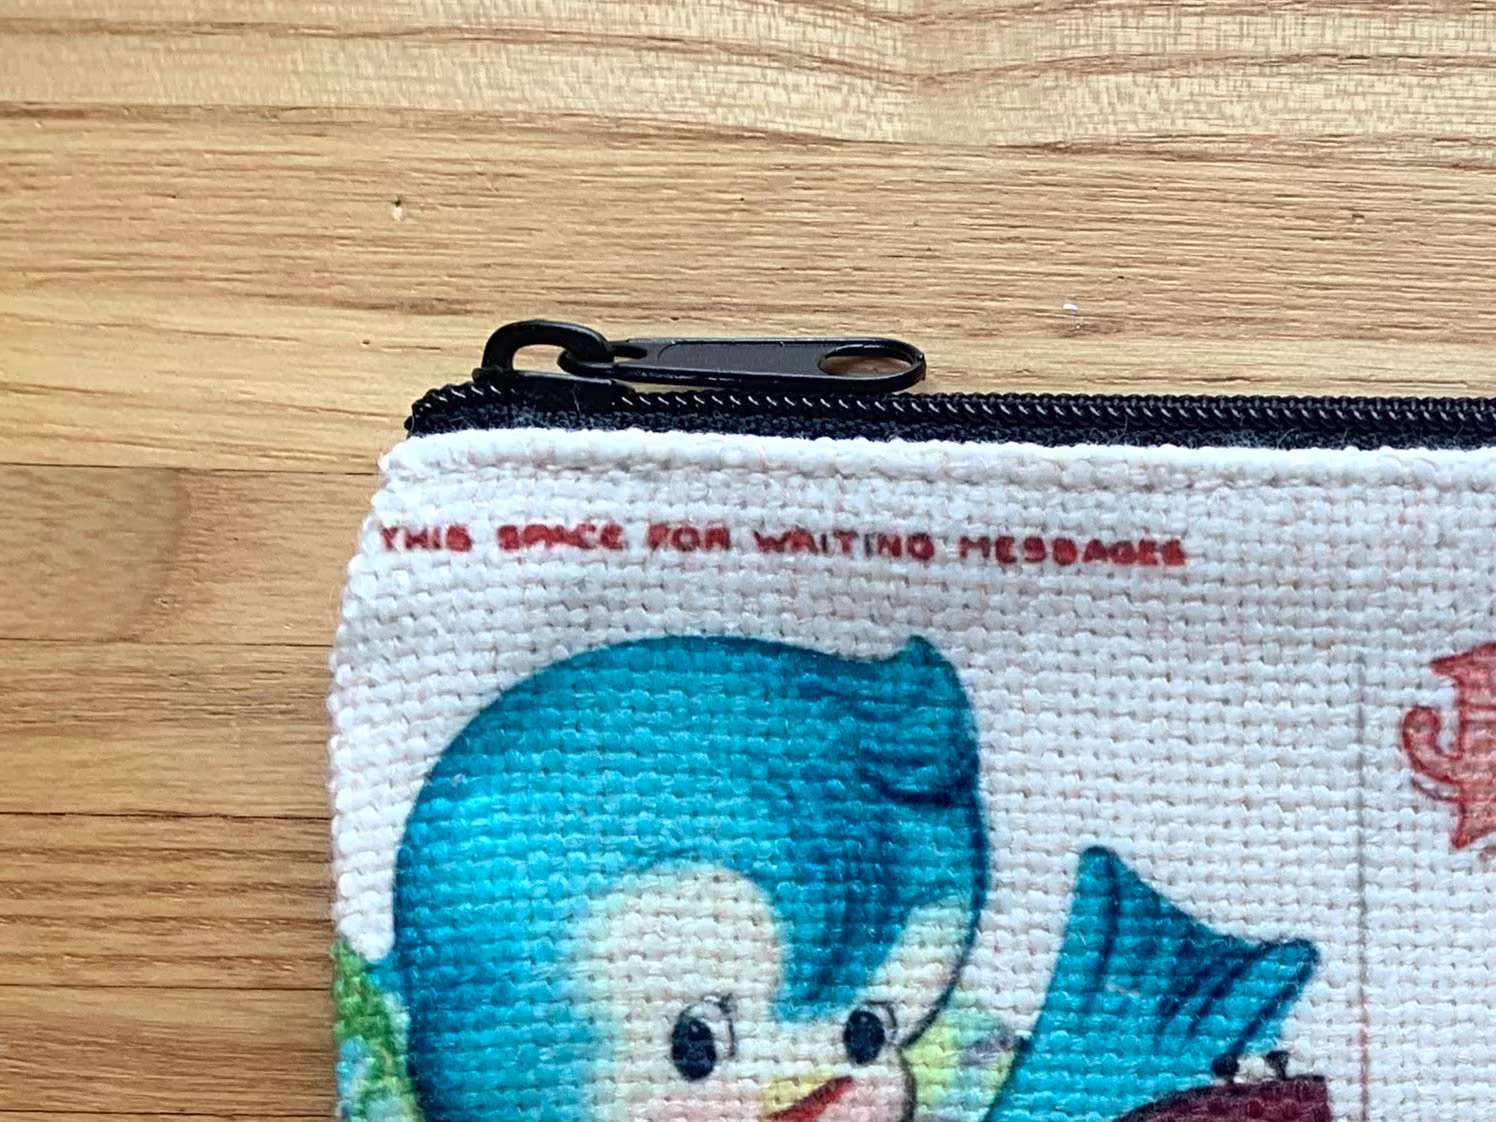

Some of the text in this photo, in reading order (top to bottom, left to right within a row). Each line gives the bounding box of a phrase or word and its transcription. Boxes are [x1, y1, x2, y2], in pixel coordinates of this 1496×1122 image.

[378, 522, 473, 552] THIS
[496, 521, 627, 552] SPACE
[646, 519, 731, 552] FOR
[957, 534, 1187, 567] MESSAGES
